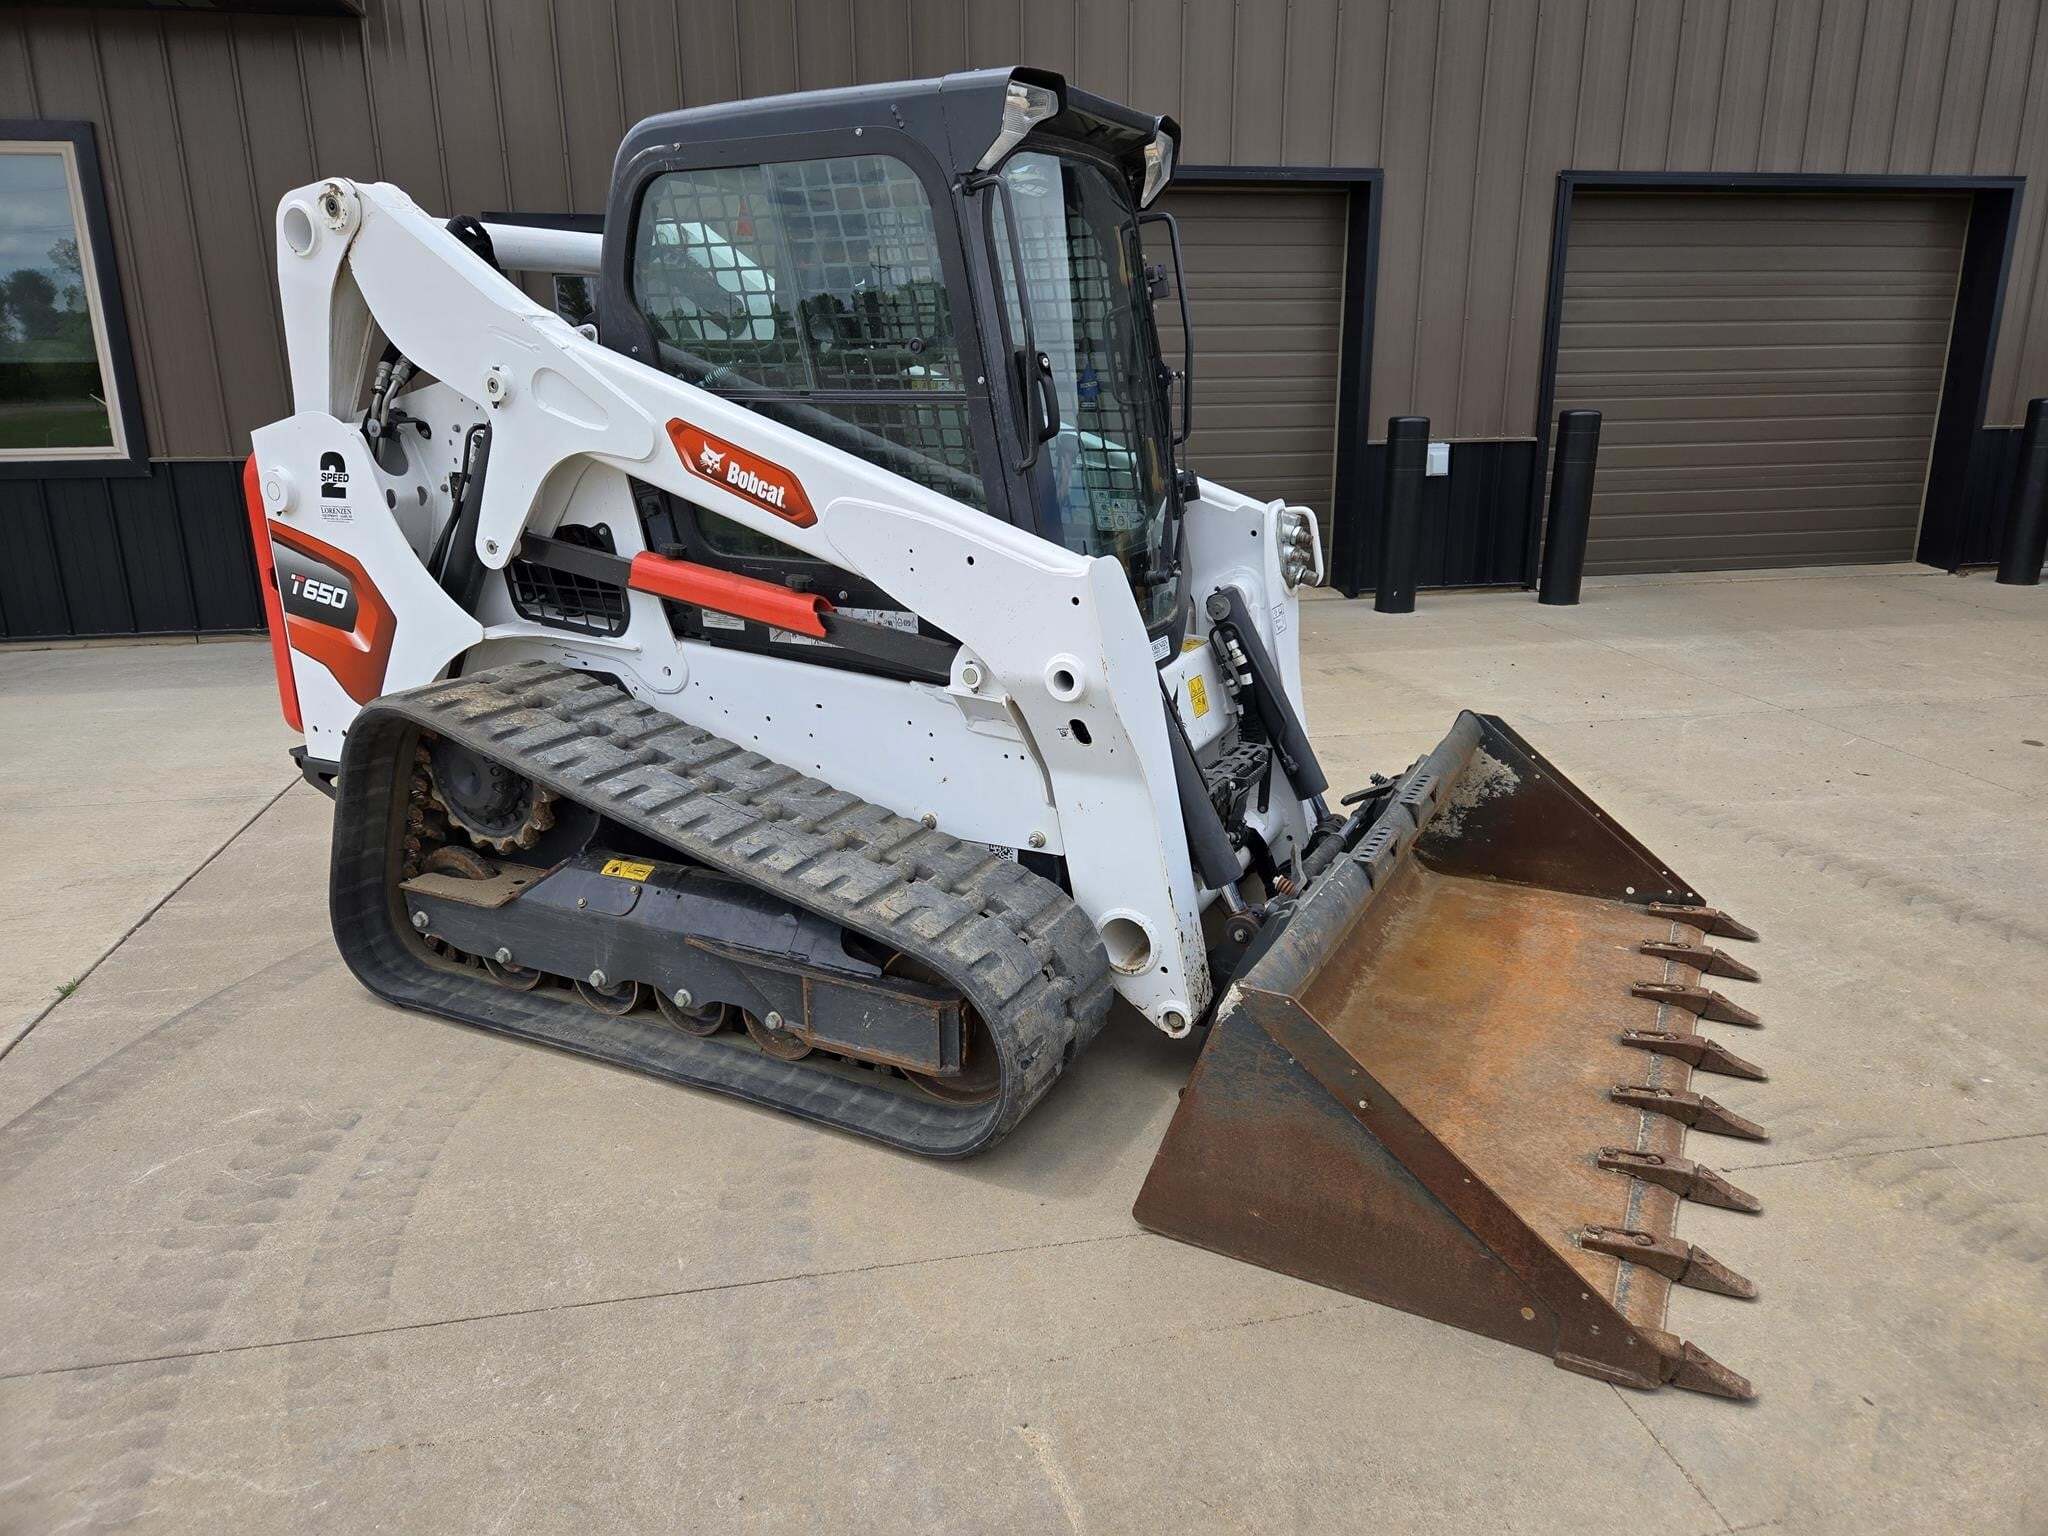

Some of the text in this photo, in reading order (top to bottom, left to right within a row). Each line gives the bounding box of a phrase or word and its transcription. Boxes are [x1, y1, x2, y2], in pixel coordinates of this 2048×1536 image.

[320, 451, 347, 499] 2
[320, 472, 350, 483] SPEED
[726, 461, 785, 507] Bobcat
[290, 573, 348, 609] T650
